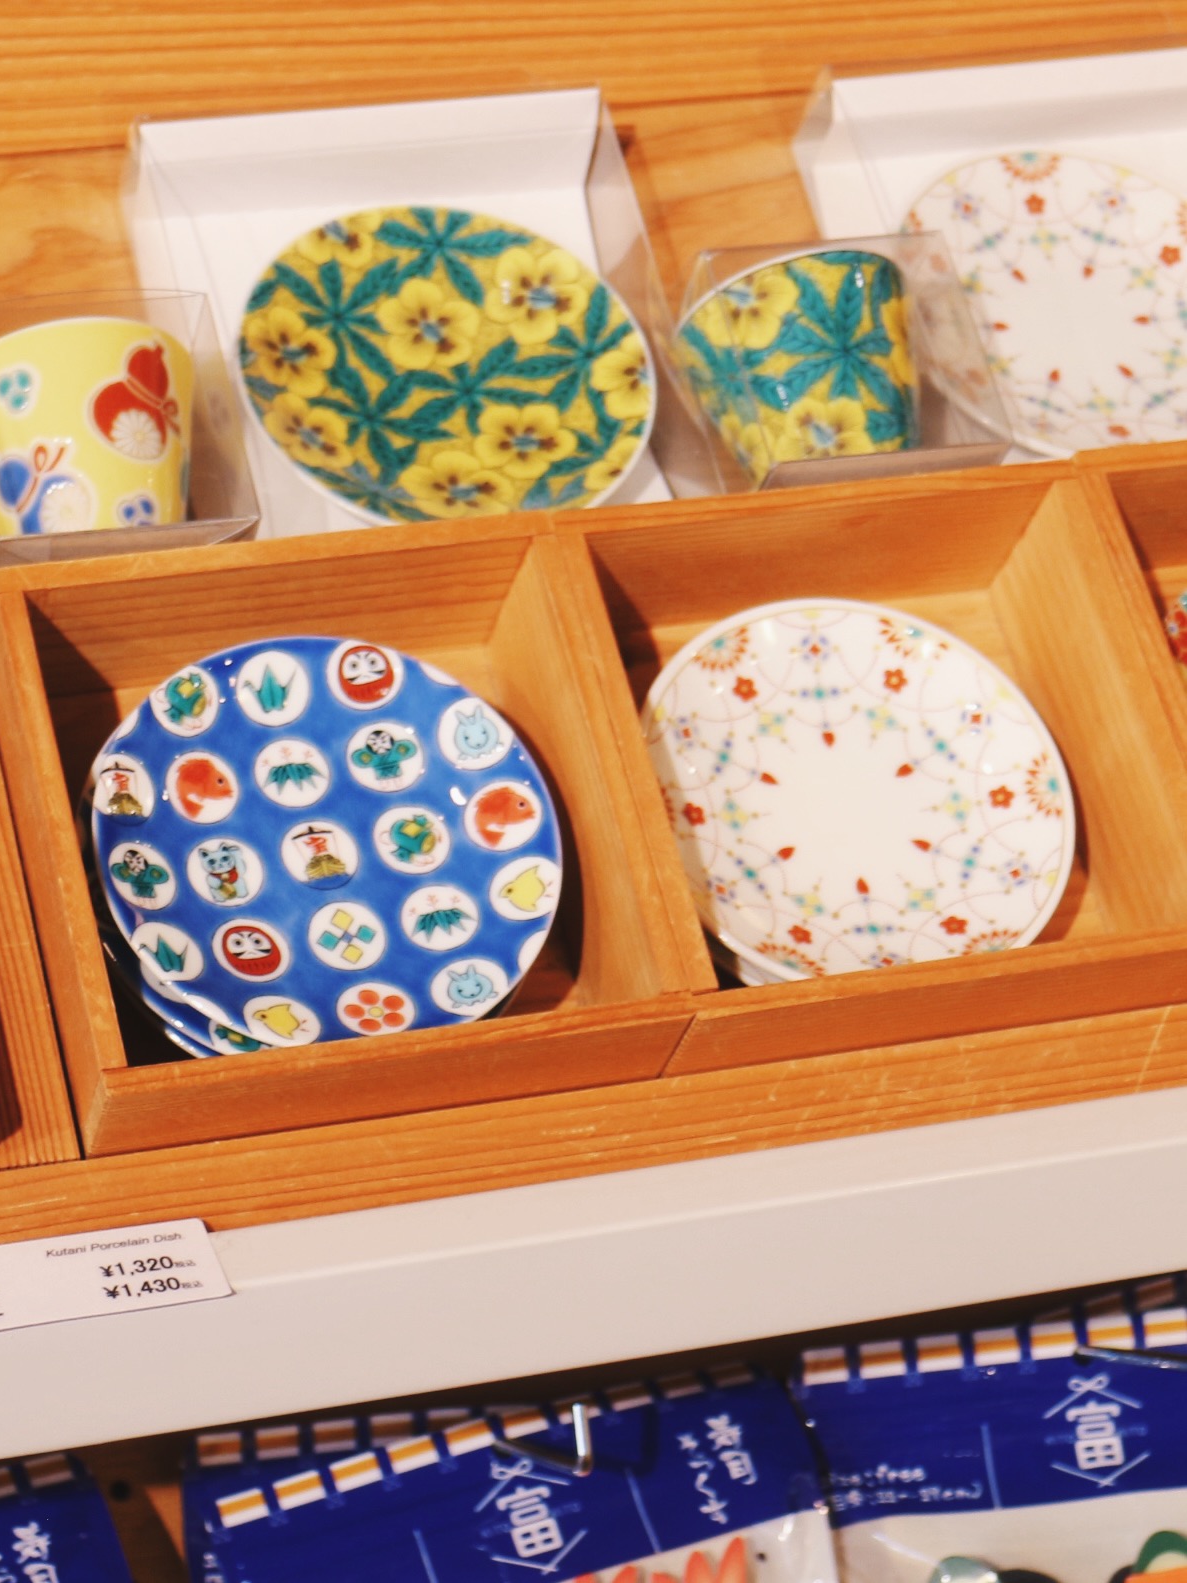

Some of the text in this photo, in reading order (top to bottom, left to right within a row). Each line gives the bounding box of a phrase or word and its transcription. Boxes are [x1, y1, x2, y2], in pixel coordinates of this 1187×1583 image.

[46, 1232, 181, 1257] Kutani Porcelain Dish
[1065, 1399, 1125, 1471] 富
[495, 1486, 564, 1558] 富
